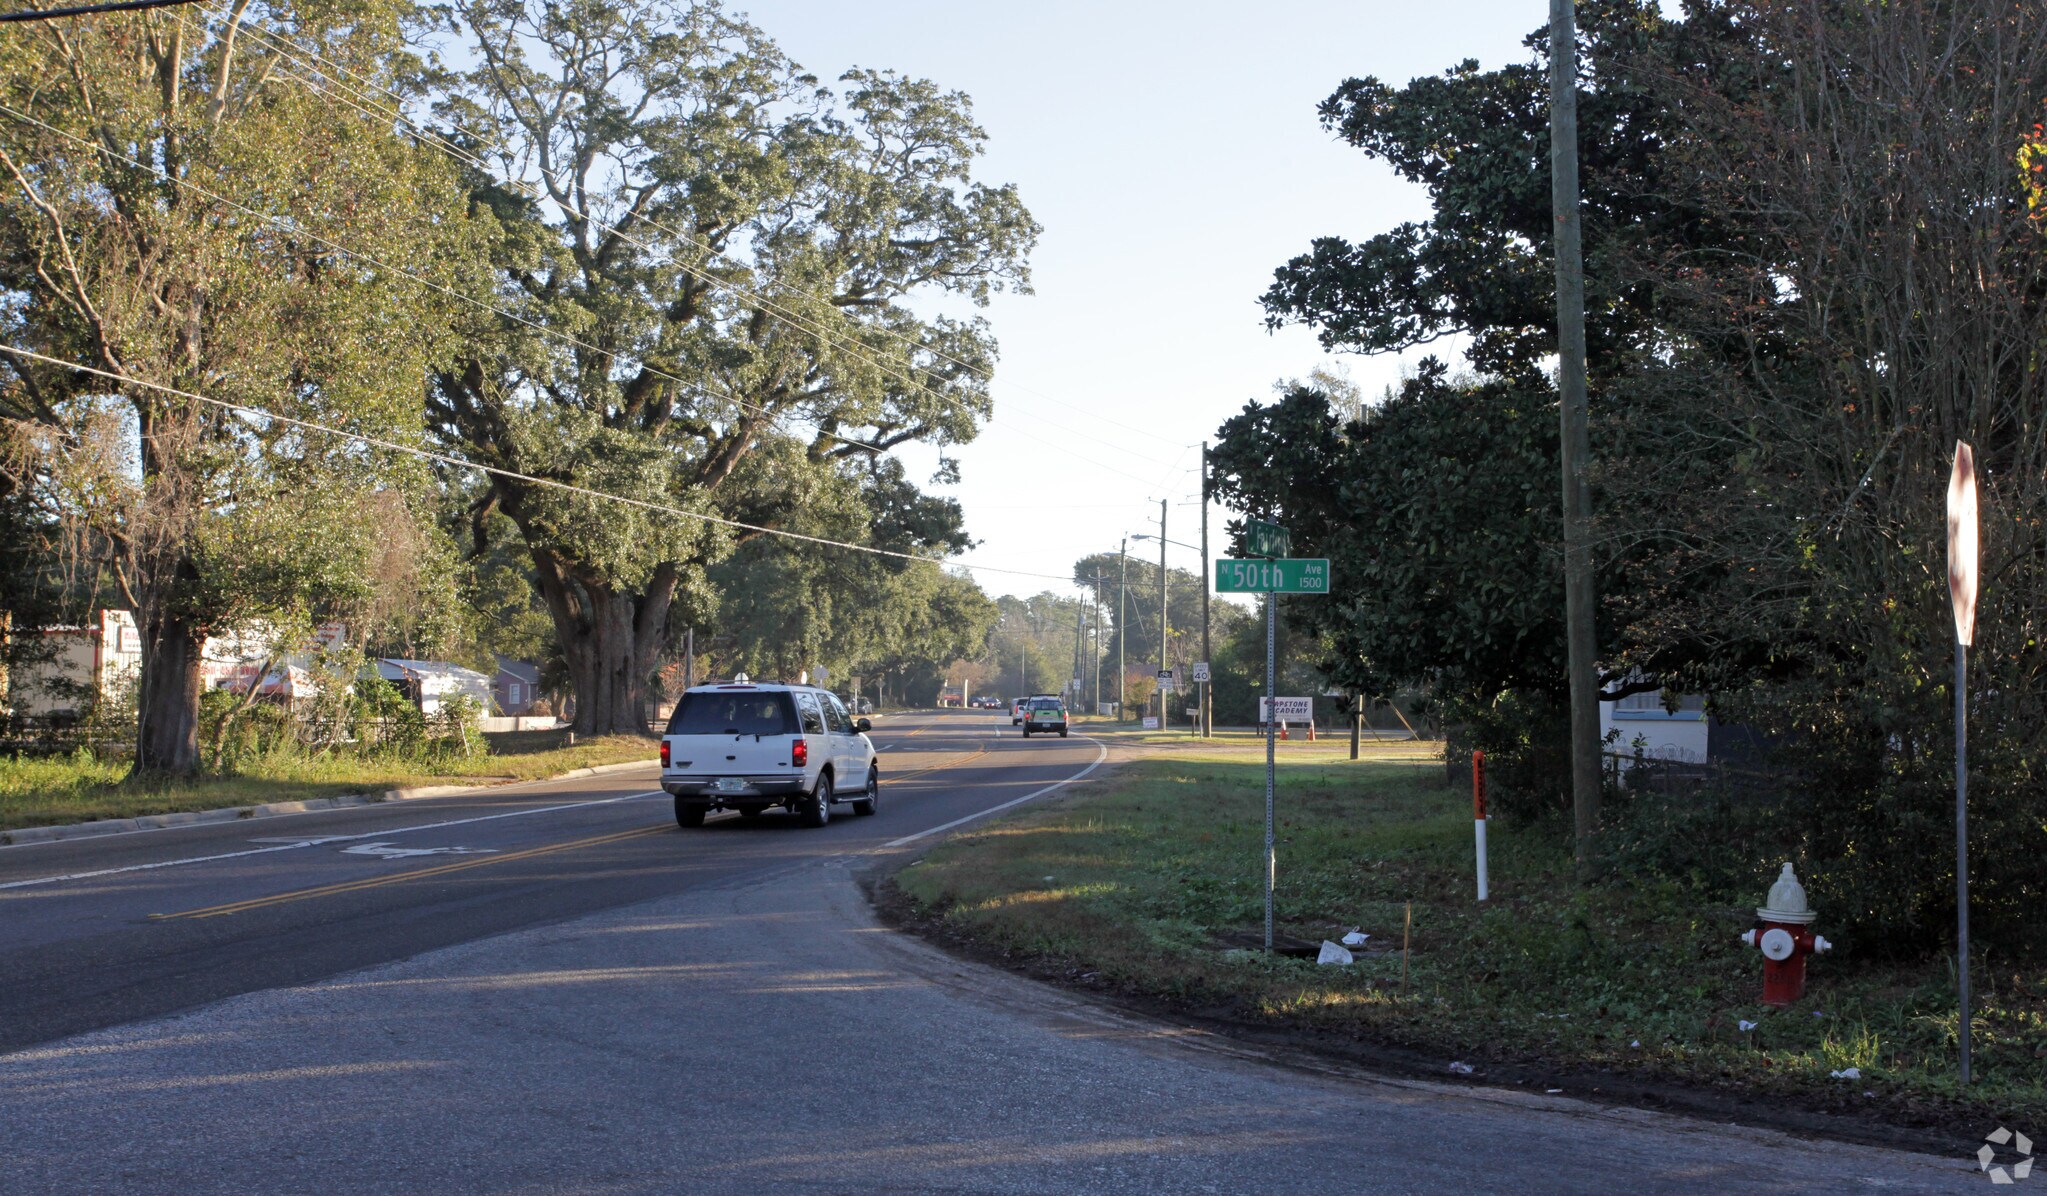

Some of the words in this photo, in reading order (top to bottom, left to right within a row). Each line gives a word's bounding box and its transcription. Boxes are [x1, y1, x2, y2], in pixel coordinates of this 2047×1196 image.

[1222, 564, 1228, 574] N
[1234, 564, 1283, 588] 50th
[1305, 564, 1322, 574] Ave
[1300, 577, 1322, 588] 1500
[1194, 672, 1208, 680] 40
